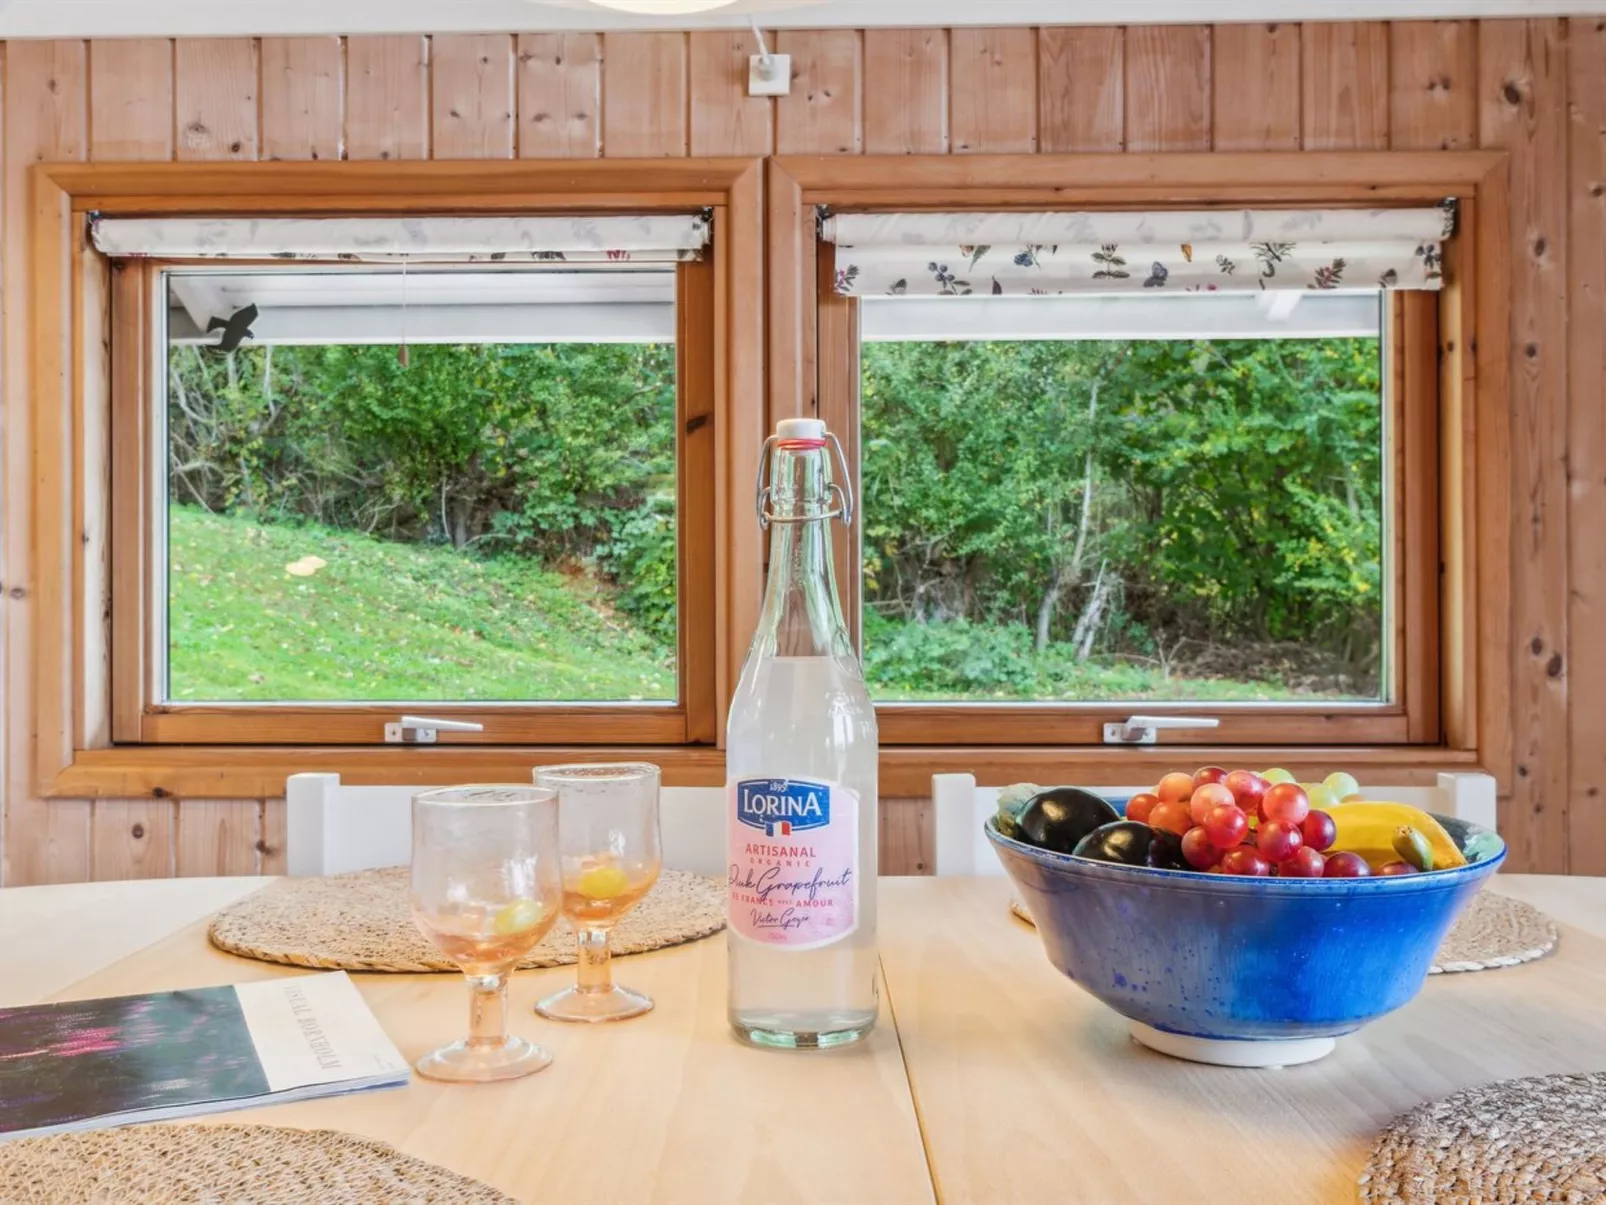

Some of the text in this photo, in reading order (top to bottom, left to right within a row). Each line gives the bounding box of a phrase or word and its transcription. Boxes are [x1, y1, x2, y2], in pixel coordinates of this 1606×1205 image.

[743, 789, 822, 817] LORINA
[745, 843, 817, 858] ARTISANAL
[755, 866, 853, 901] Grapefruit
[795, 899, 834, 908] AMOUR
